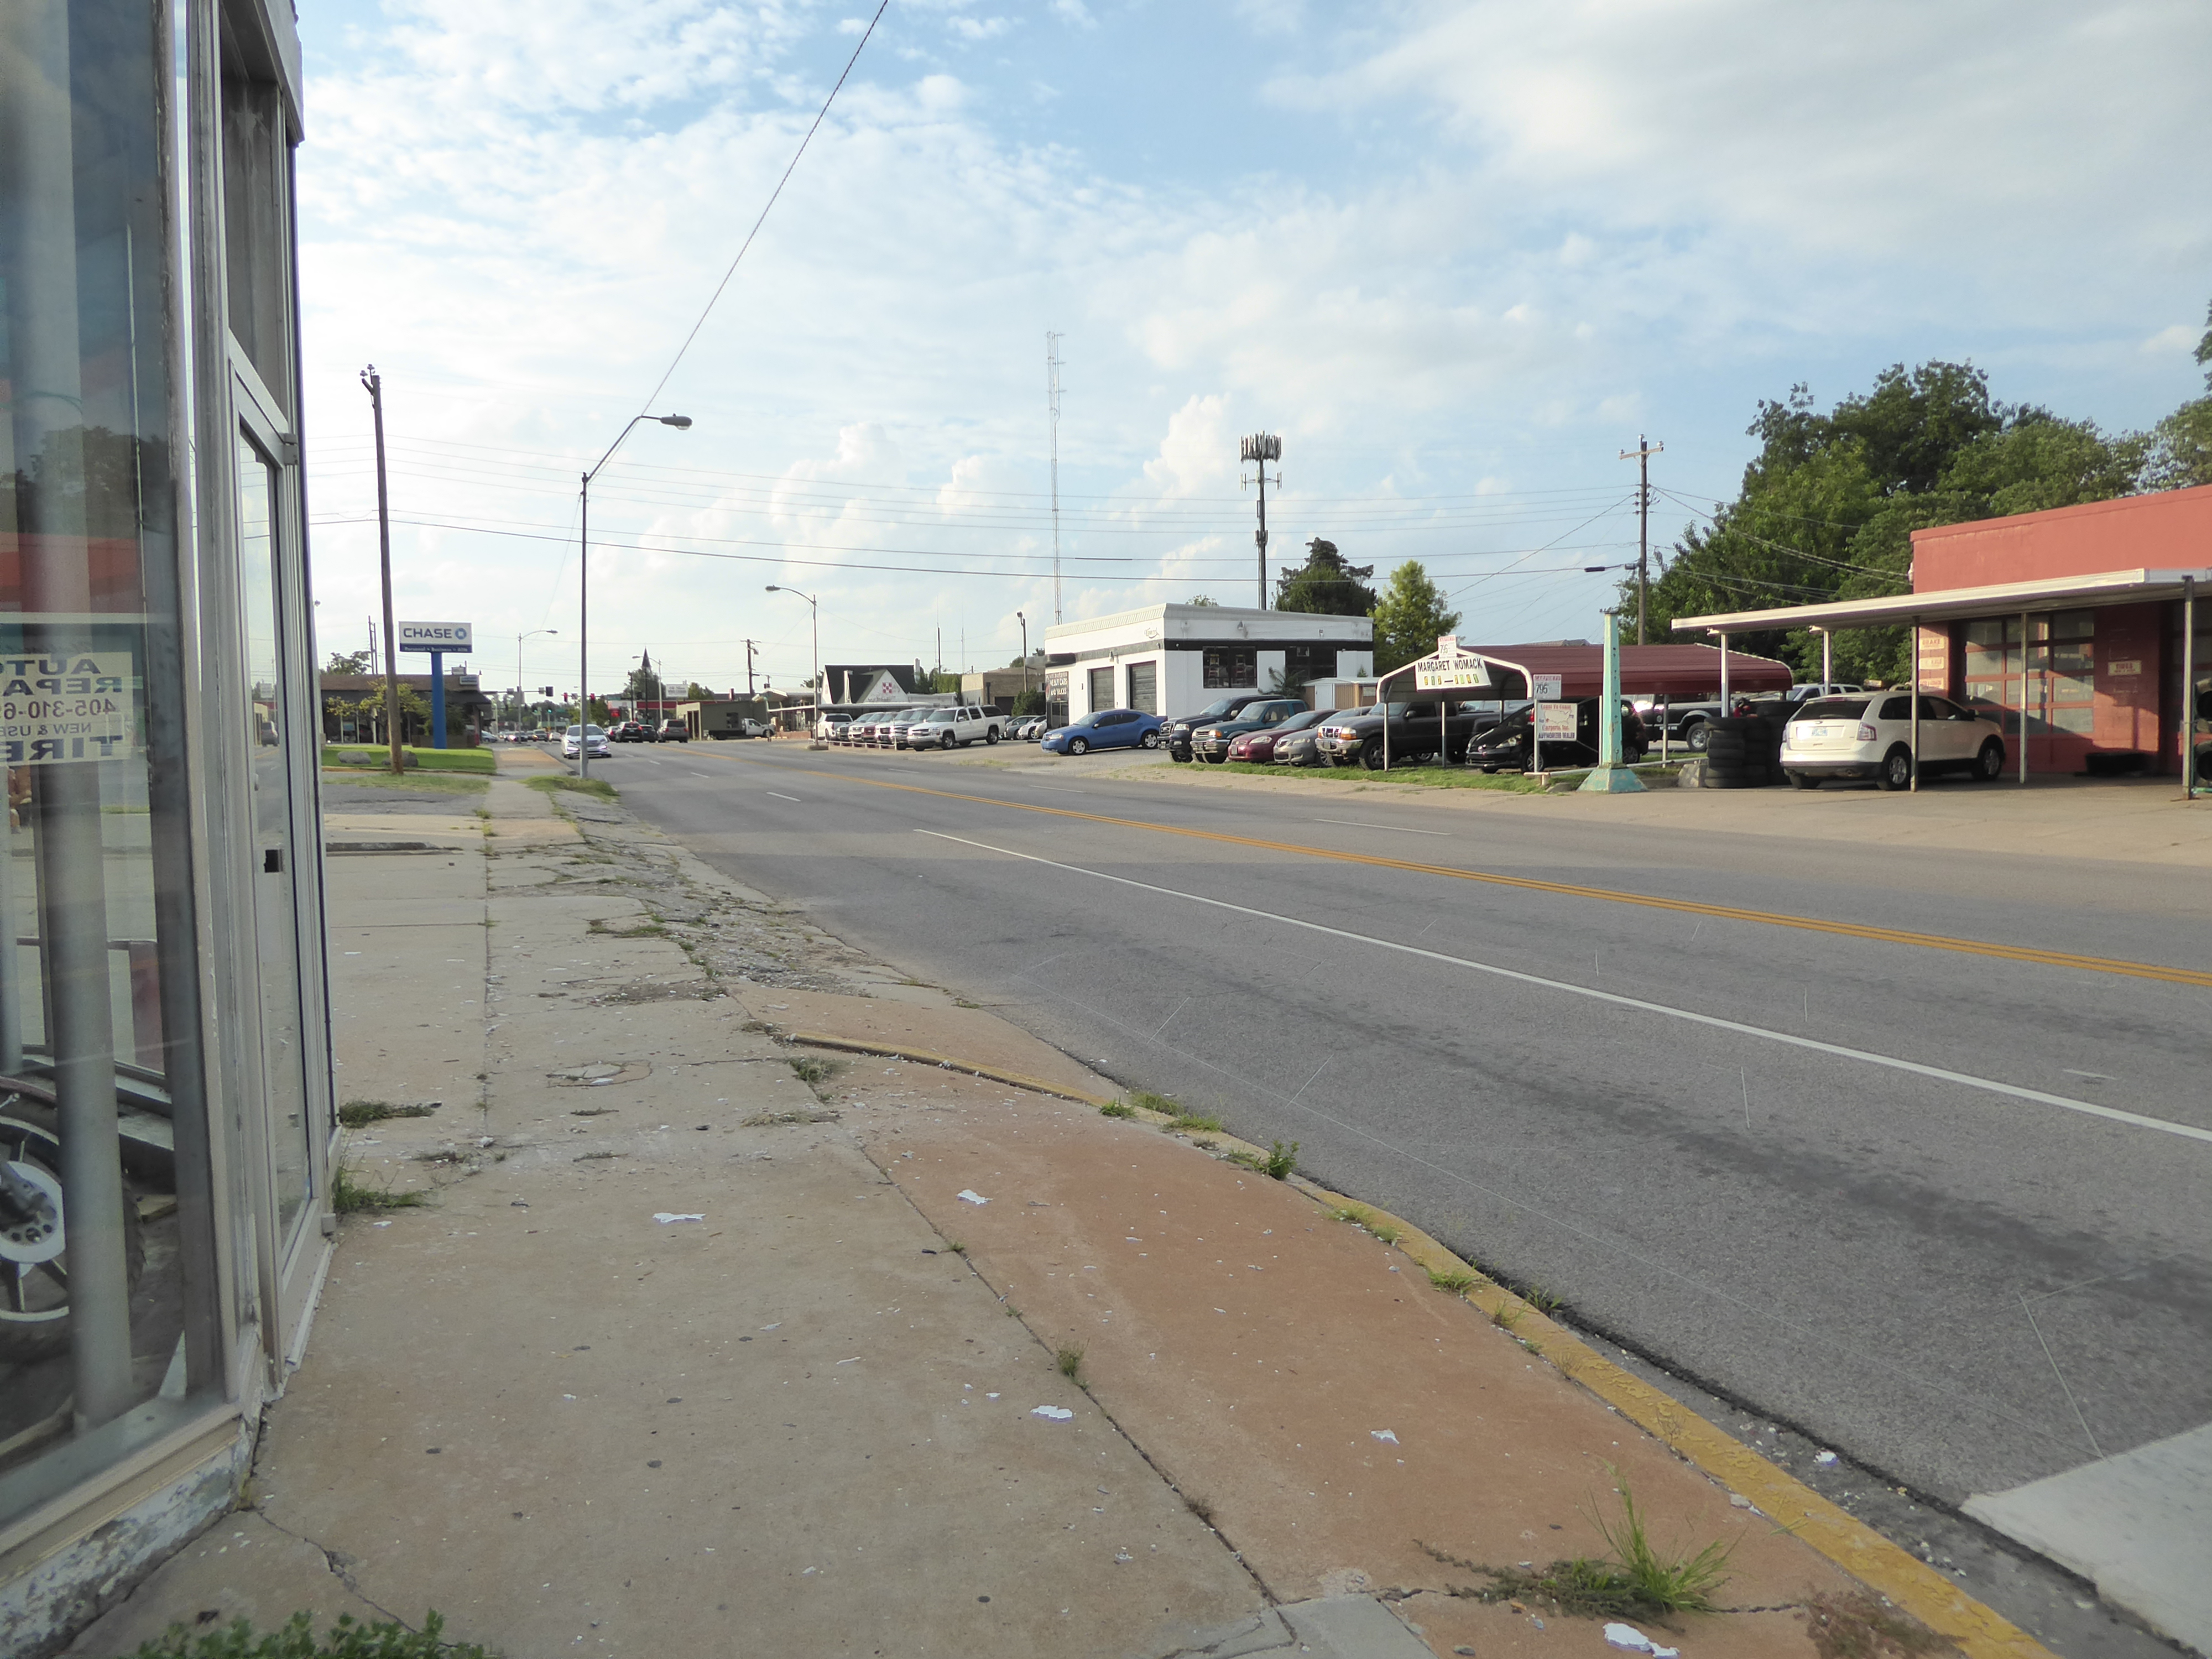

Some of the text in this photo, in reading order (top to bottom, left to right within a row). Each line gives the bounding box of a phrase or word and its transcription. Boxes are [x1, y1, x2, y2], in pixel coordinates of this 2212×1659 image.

[403, 628, 452, 639] CHASE
[1418, 658, 1483, 672] MARGARET WOMACK
